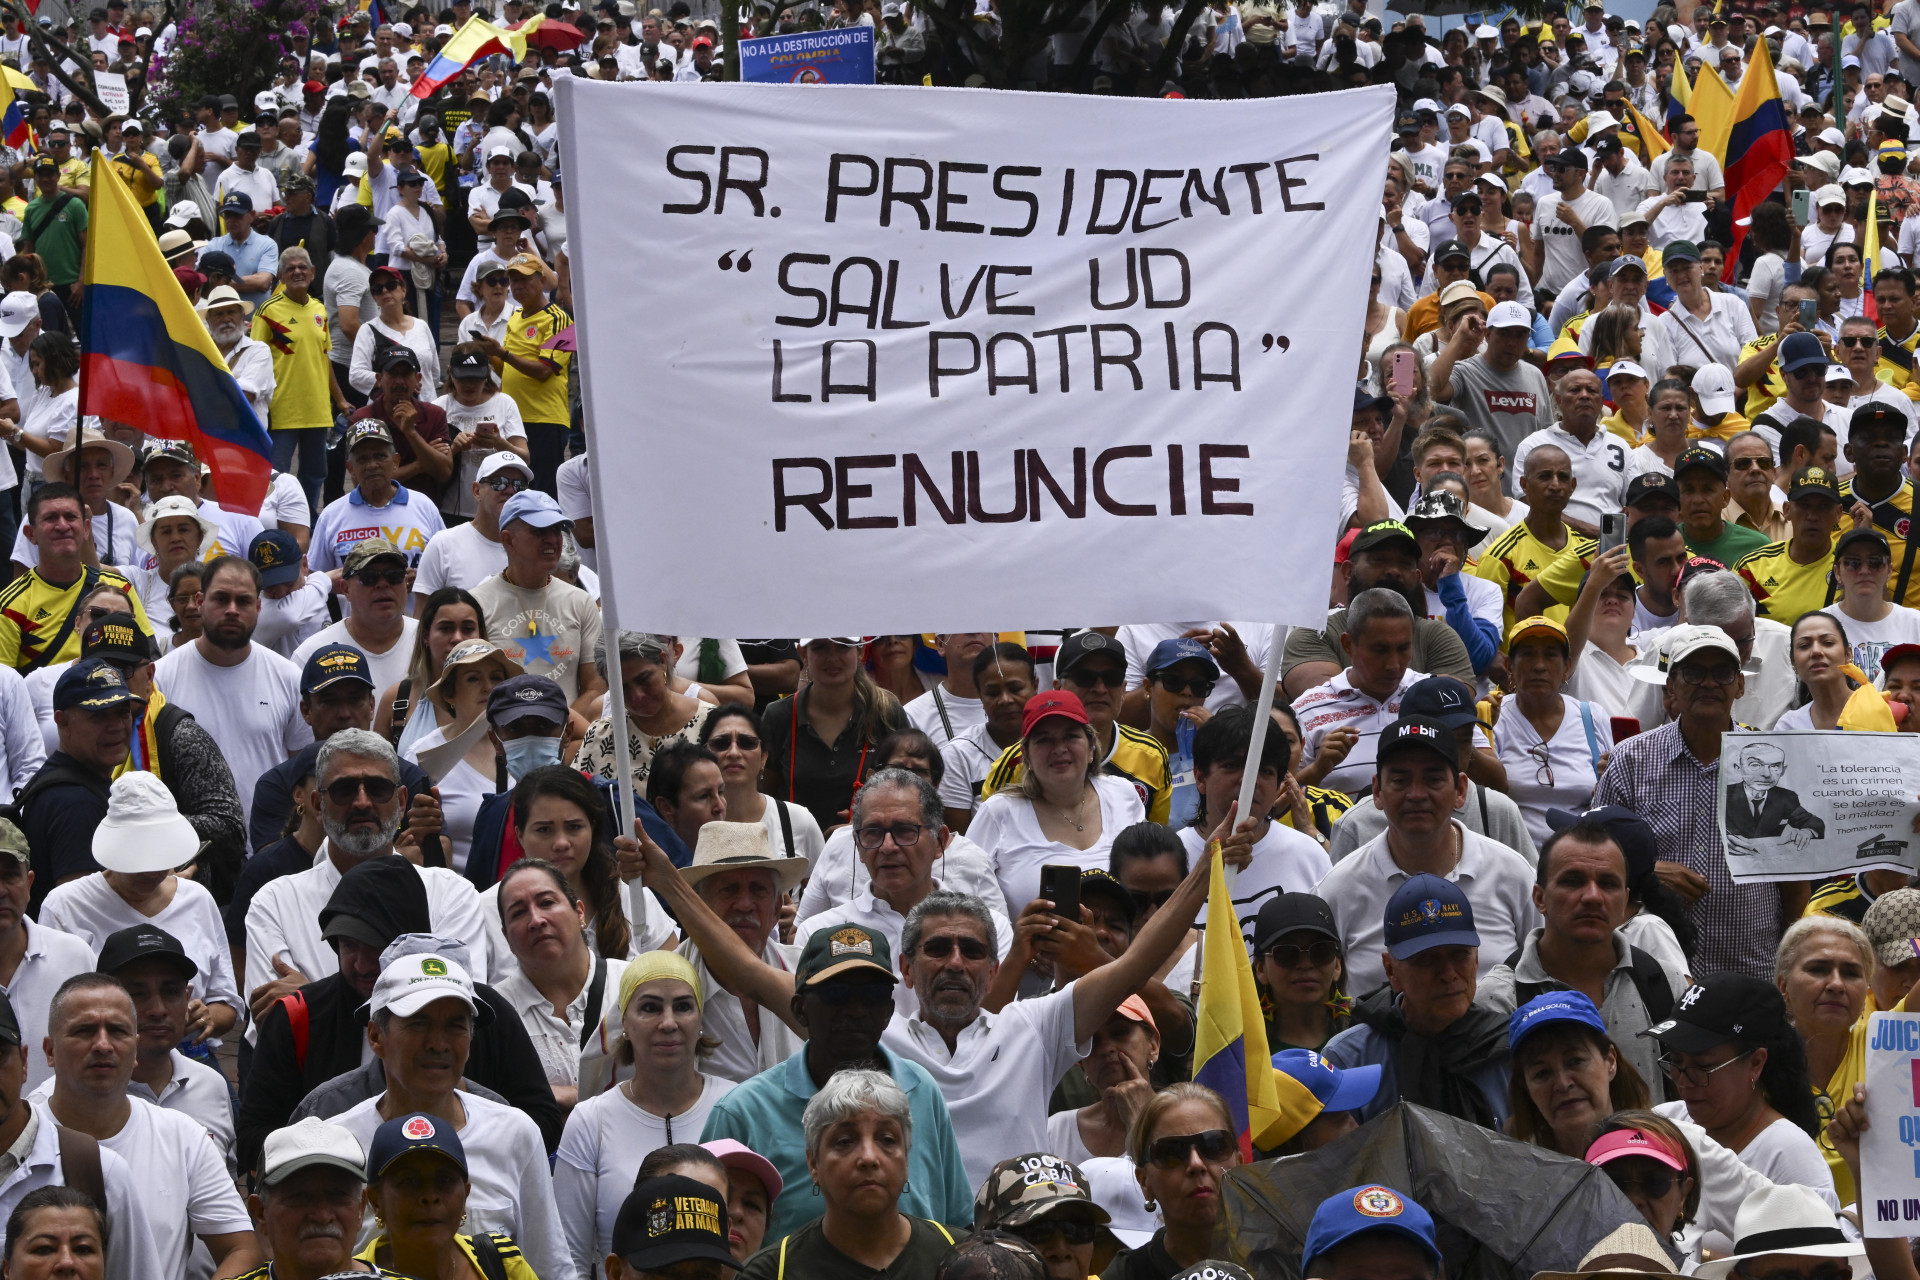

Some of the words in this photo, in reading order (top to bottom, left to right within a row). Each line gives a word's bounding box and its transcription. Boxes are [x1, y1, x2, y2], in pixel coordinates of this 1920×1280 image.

[742, 46, 756, 58] NO
[760, 45, 766, 56] A
[768, 43, 782, 54] LA
[784, 32, 851, 53] DESTRUCCIÓN
[854, 32, 868, 44] DE
[662, 144, 782, 219] SR.
[824, 152, 1326, 238] PRESIDENTE
[1088, 247, 1191, 311] UD
[771, 338, 877, 403] LA
[356, 426, 378, 436] CABAL
[1607, 444, 1624, 472] 3
[1682, 448, 1715, 461] VETERANO
[772, 443, 1254, 533] RENUNCIE
[1800, 478, 1832, 488] GAULA
[340, 530, 378, 541] JUICIO
[380, 526, 425, 552] YA
[104, 626, 134, 634] VETERANO
[502, 610, 567, 637] CONVERSE
[105, 633, 134, 642] FUERZA
[552, 646, 575, 660] Taylor
[324, 665, 358, 674] VETERANO
[544, 662, 568, 681] TAR
[1398, 725, 1436, 738] Mobil
[1840, 764, 1902, 774] tolerancia
[1812, 788, 1864, 798] cuando
[1867, 788, 1878, 796] lo
[1882, 790, 1905, 798] que
[1852, 800, 1886, 808] tolera
[1836, 812, 1846, 820] la
[1836, 826, 1868, 834] Thomas
[1442, 904, 1459, 912] NAVY
[408, 977, 434, 986] JOHN
[434, 976, 463, 986] DEERE
[1528, 1003, 1570, 1018] BELLSOUTH
[1871, 1020, 1920, 1052] JUIC
[1020, 1155, 1072, 1173] 100%
[1024, 1168, 1078, 1187] CABAL
[674, 1197, 719, 1214] VETERANO
[1877, 1200, 1899, 1222] NO
[676, 1213, 722, 1237] ARMADA
